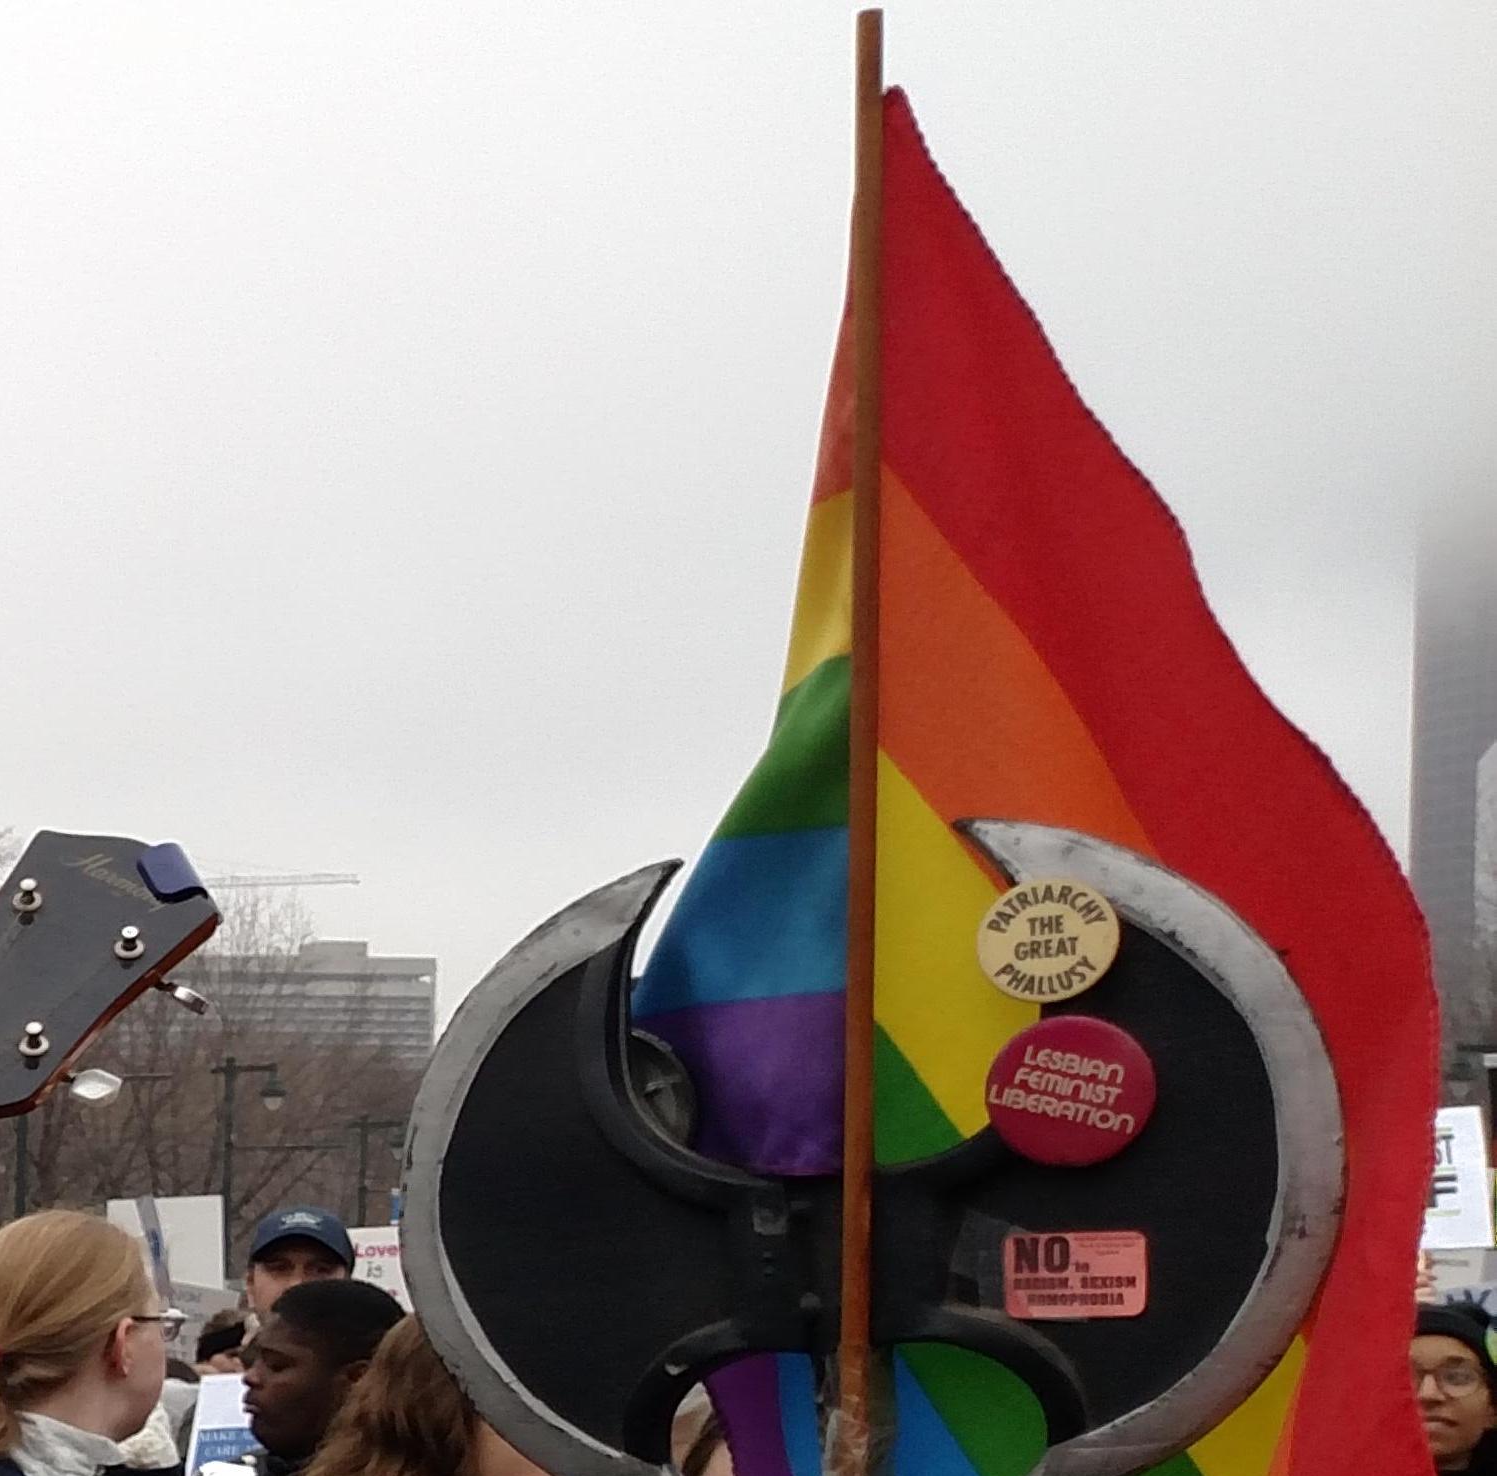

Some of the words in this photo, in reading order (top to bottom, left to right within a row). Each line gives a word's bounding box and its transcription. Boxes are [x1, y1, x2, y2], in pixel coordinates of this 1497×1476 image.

[986, 884, 1108, 934] PATRIARCHY
[1026, 914, 1065, 937] THE
[1013, 936, 1079, 961] GREAT
[993, 955, 1098, 996] PHALLUSY
[1024, 1045, 1125, 1084] LESBIAN
[1013, 1236, 1070, 1274] NO
